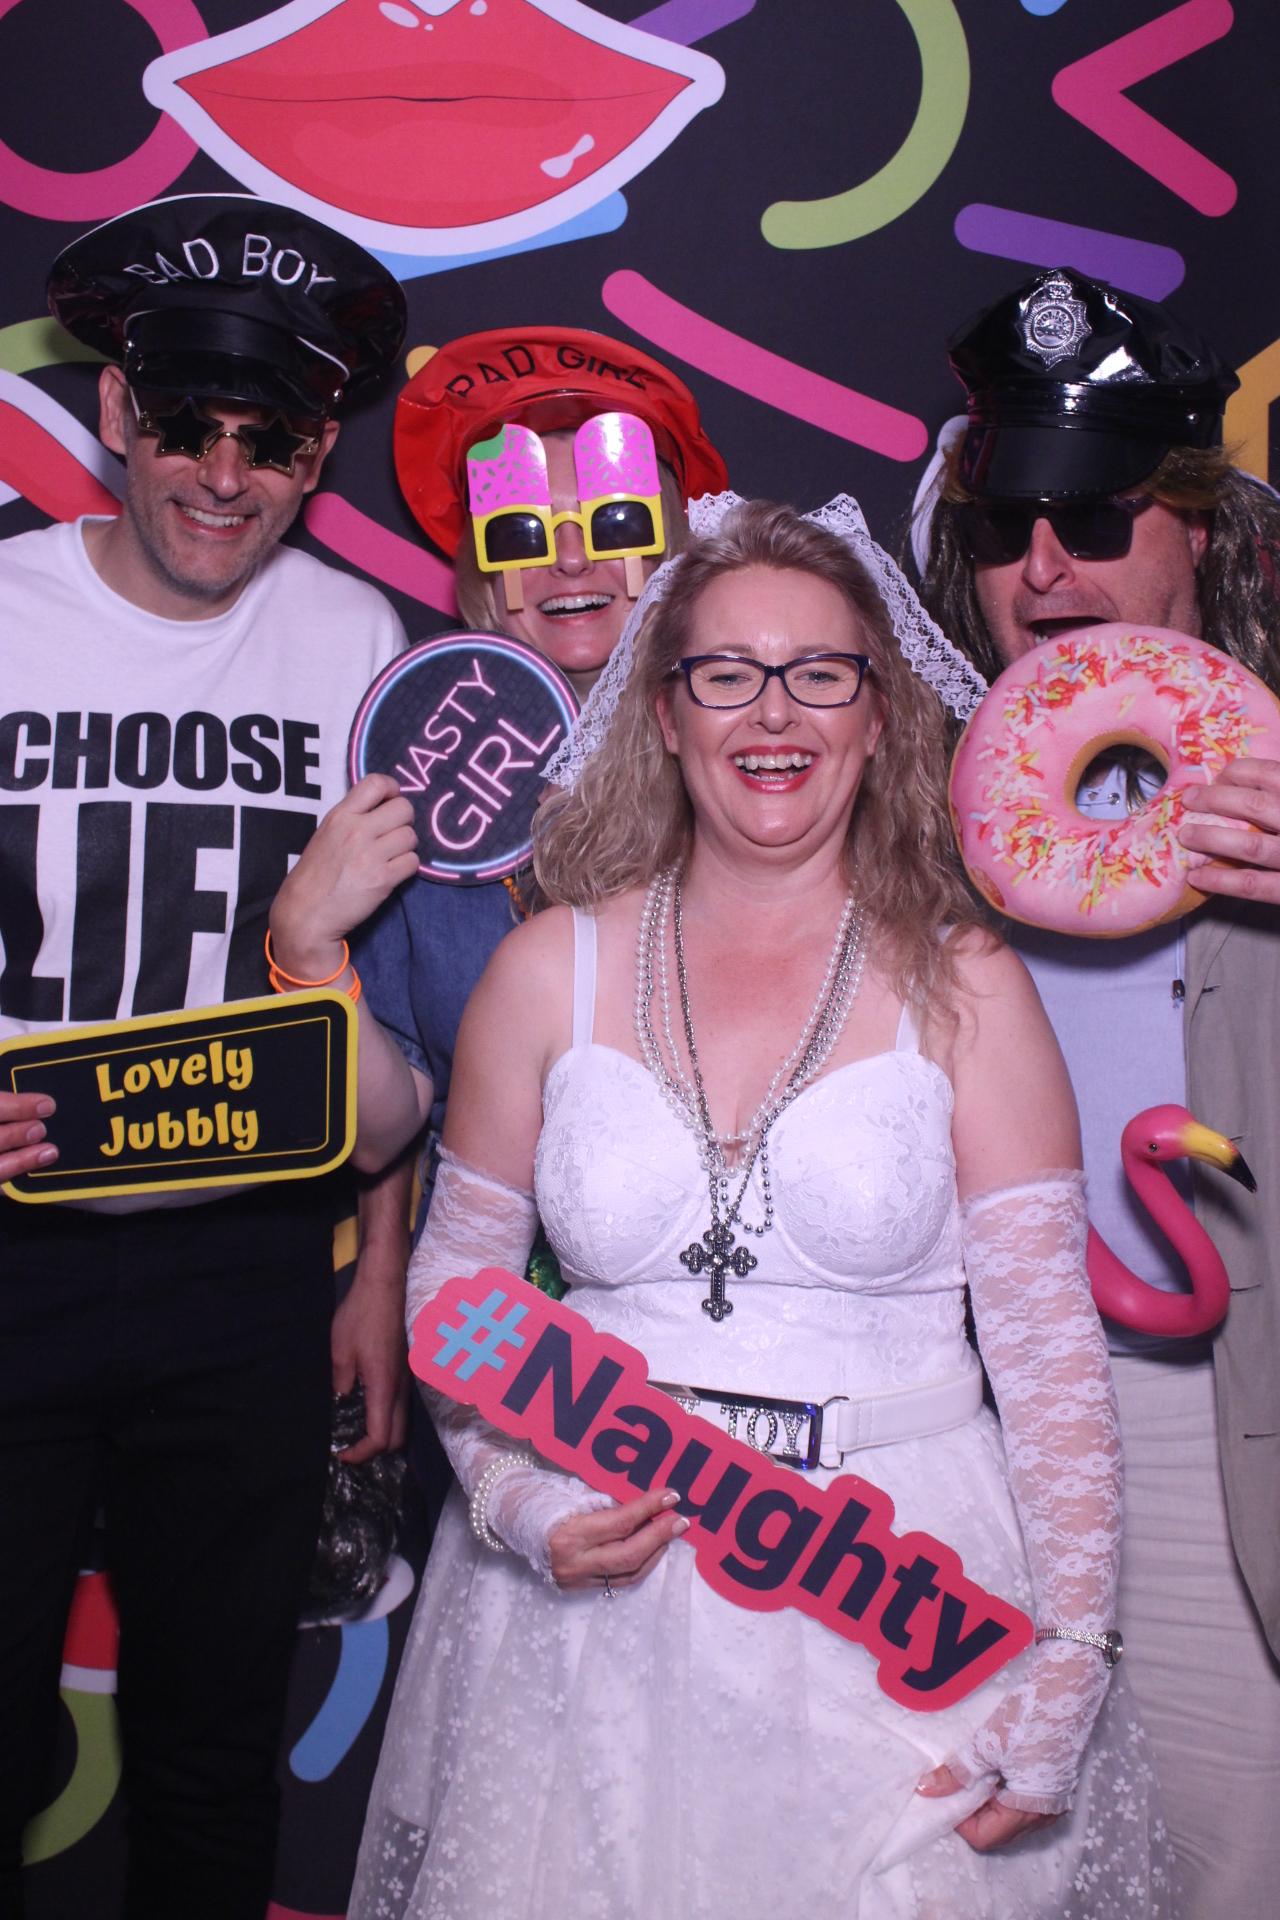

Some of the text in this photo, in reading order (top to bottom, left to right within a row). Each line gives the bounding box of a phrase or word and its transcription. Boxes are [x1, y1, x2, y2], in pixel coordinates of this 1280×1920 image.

[123, 233, 337, 295] BAD BOY
[0, 710, 323, 801] CHOOSE
[431, 718, 561, 851] GIRL
[96, 1040, 254, 1103] Lovely
[99, 1101, 259, 1157] Jubbly
[719, 1402, 811, 1456] TOY
[431, 1288, 1011, 1692] #Naughty
